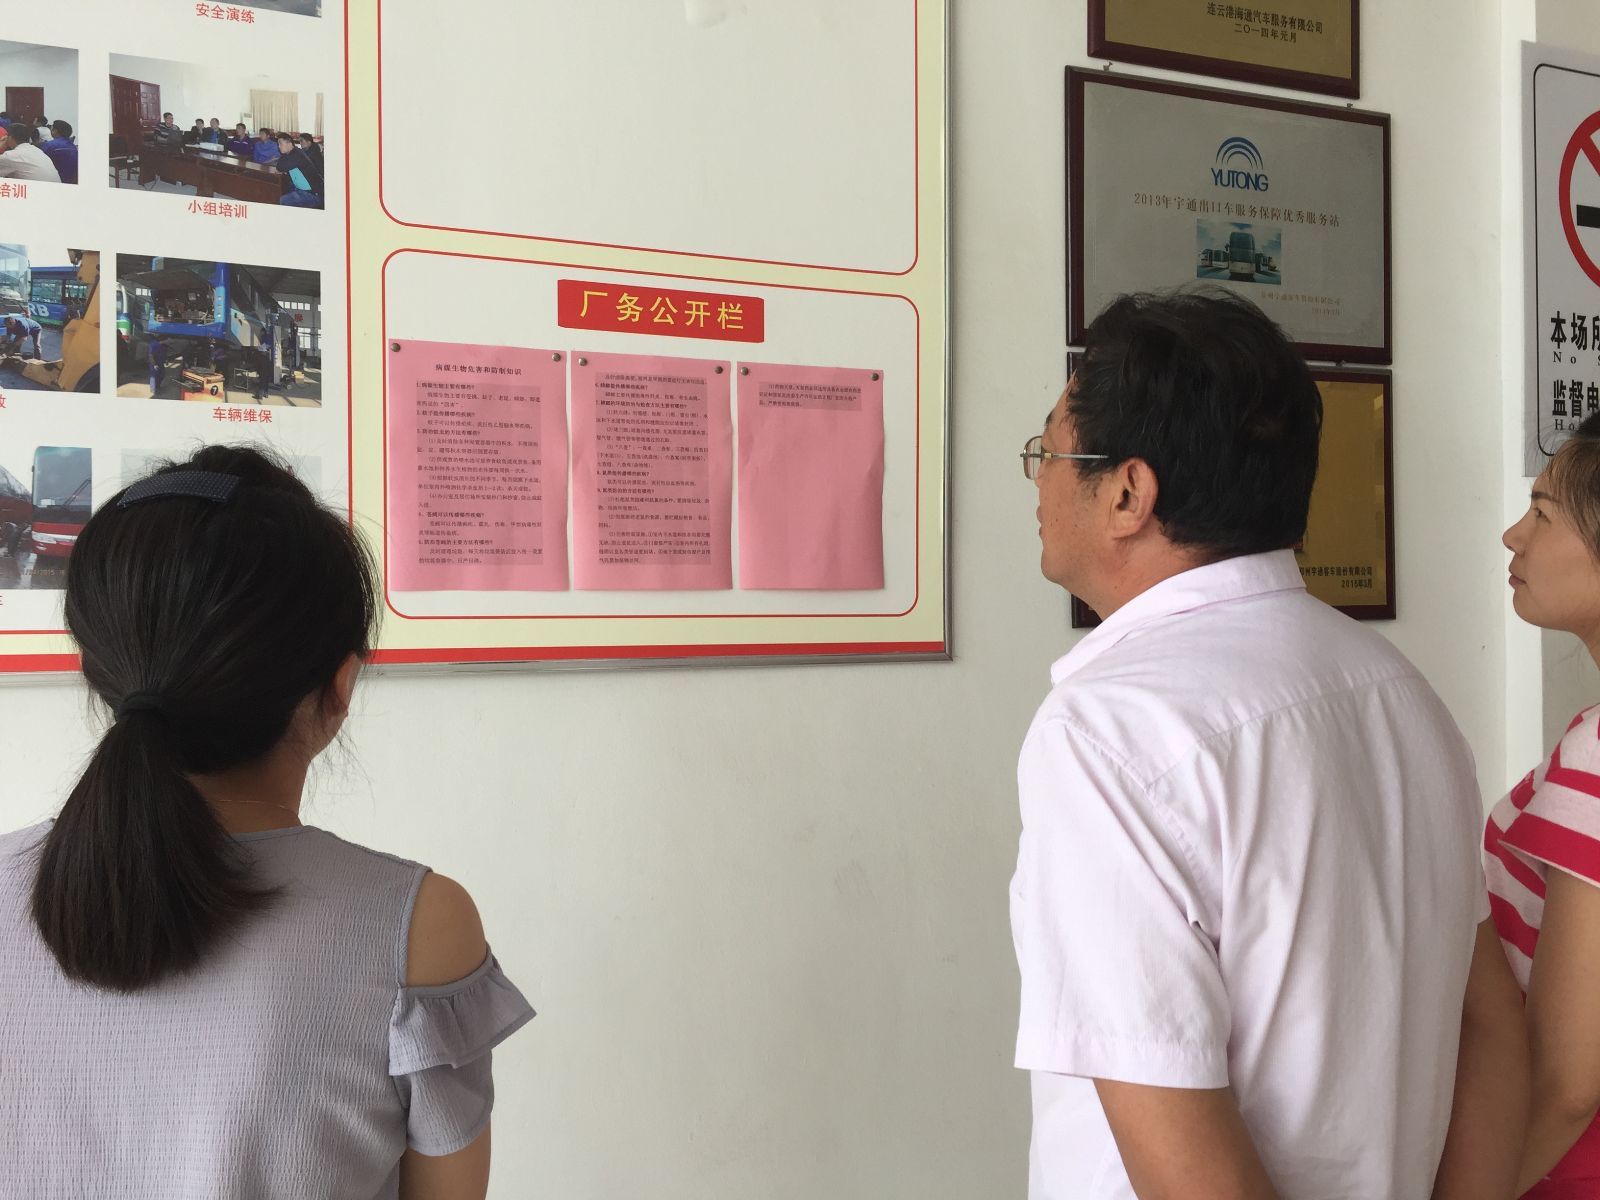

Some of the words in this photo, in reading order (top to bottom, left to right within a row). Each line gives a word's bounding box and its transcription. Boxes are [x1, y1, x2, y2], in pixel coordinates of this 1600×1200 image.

[196, 3, 255, 24] 安全演练
[1207, 2, 1323, 34] 连云港海通汽车服务有限公司
[1211, 168, 1269, 191] YUTONG
[188, 200, 248, 219] 小组培训
[580, 290, 744, 330] 厂务公开栏
[213, 407, 273, 424] 车辆维保
